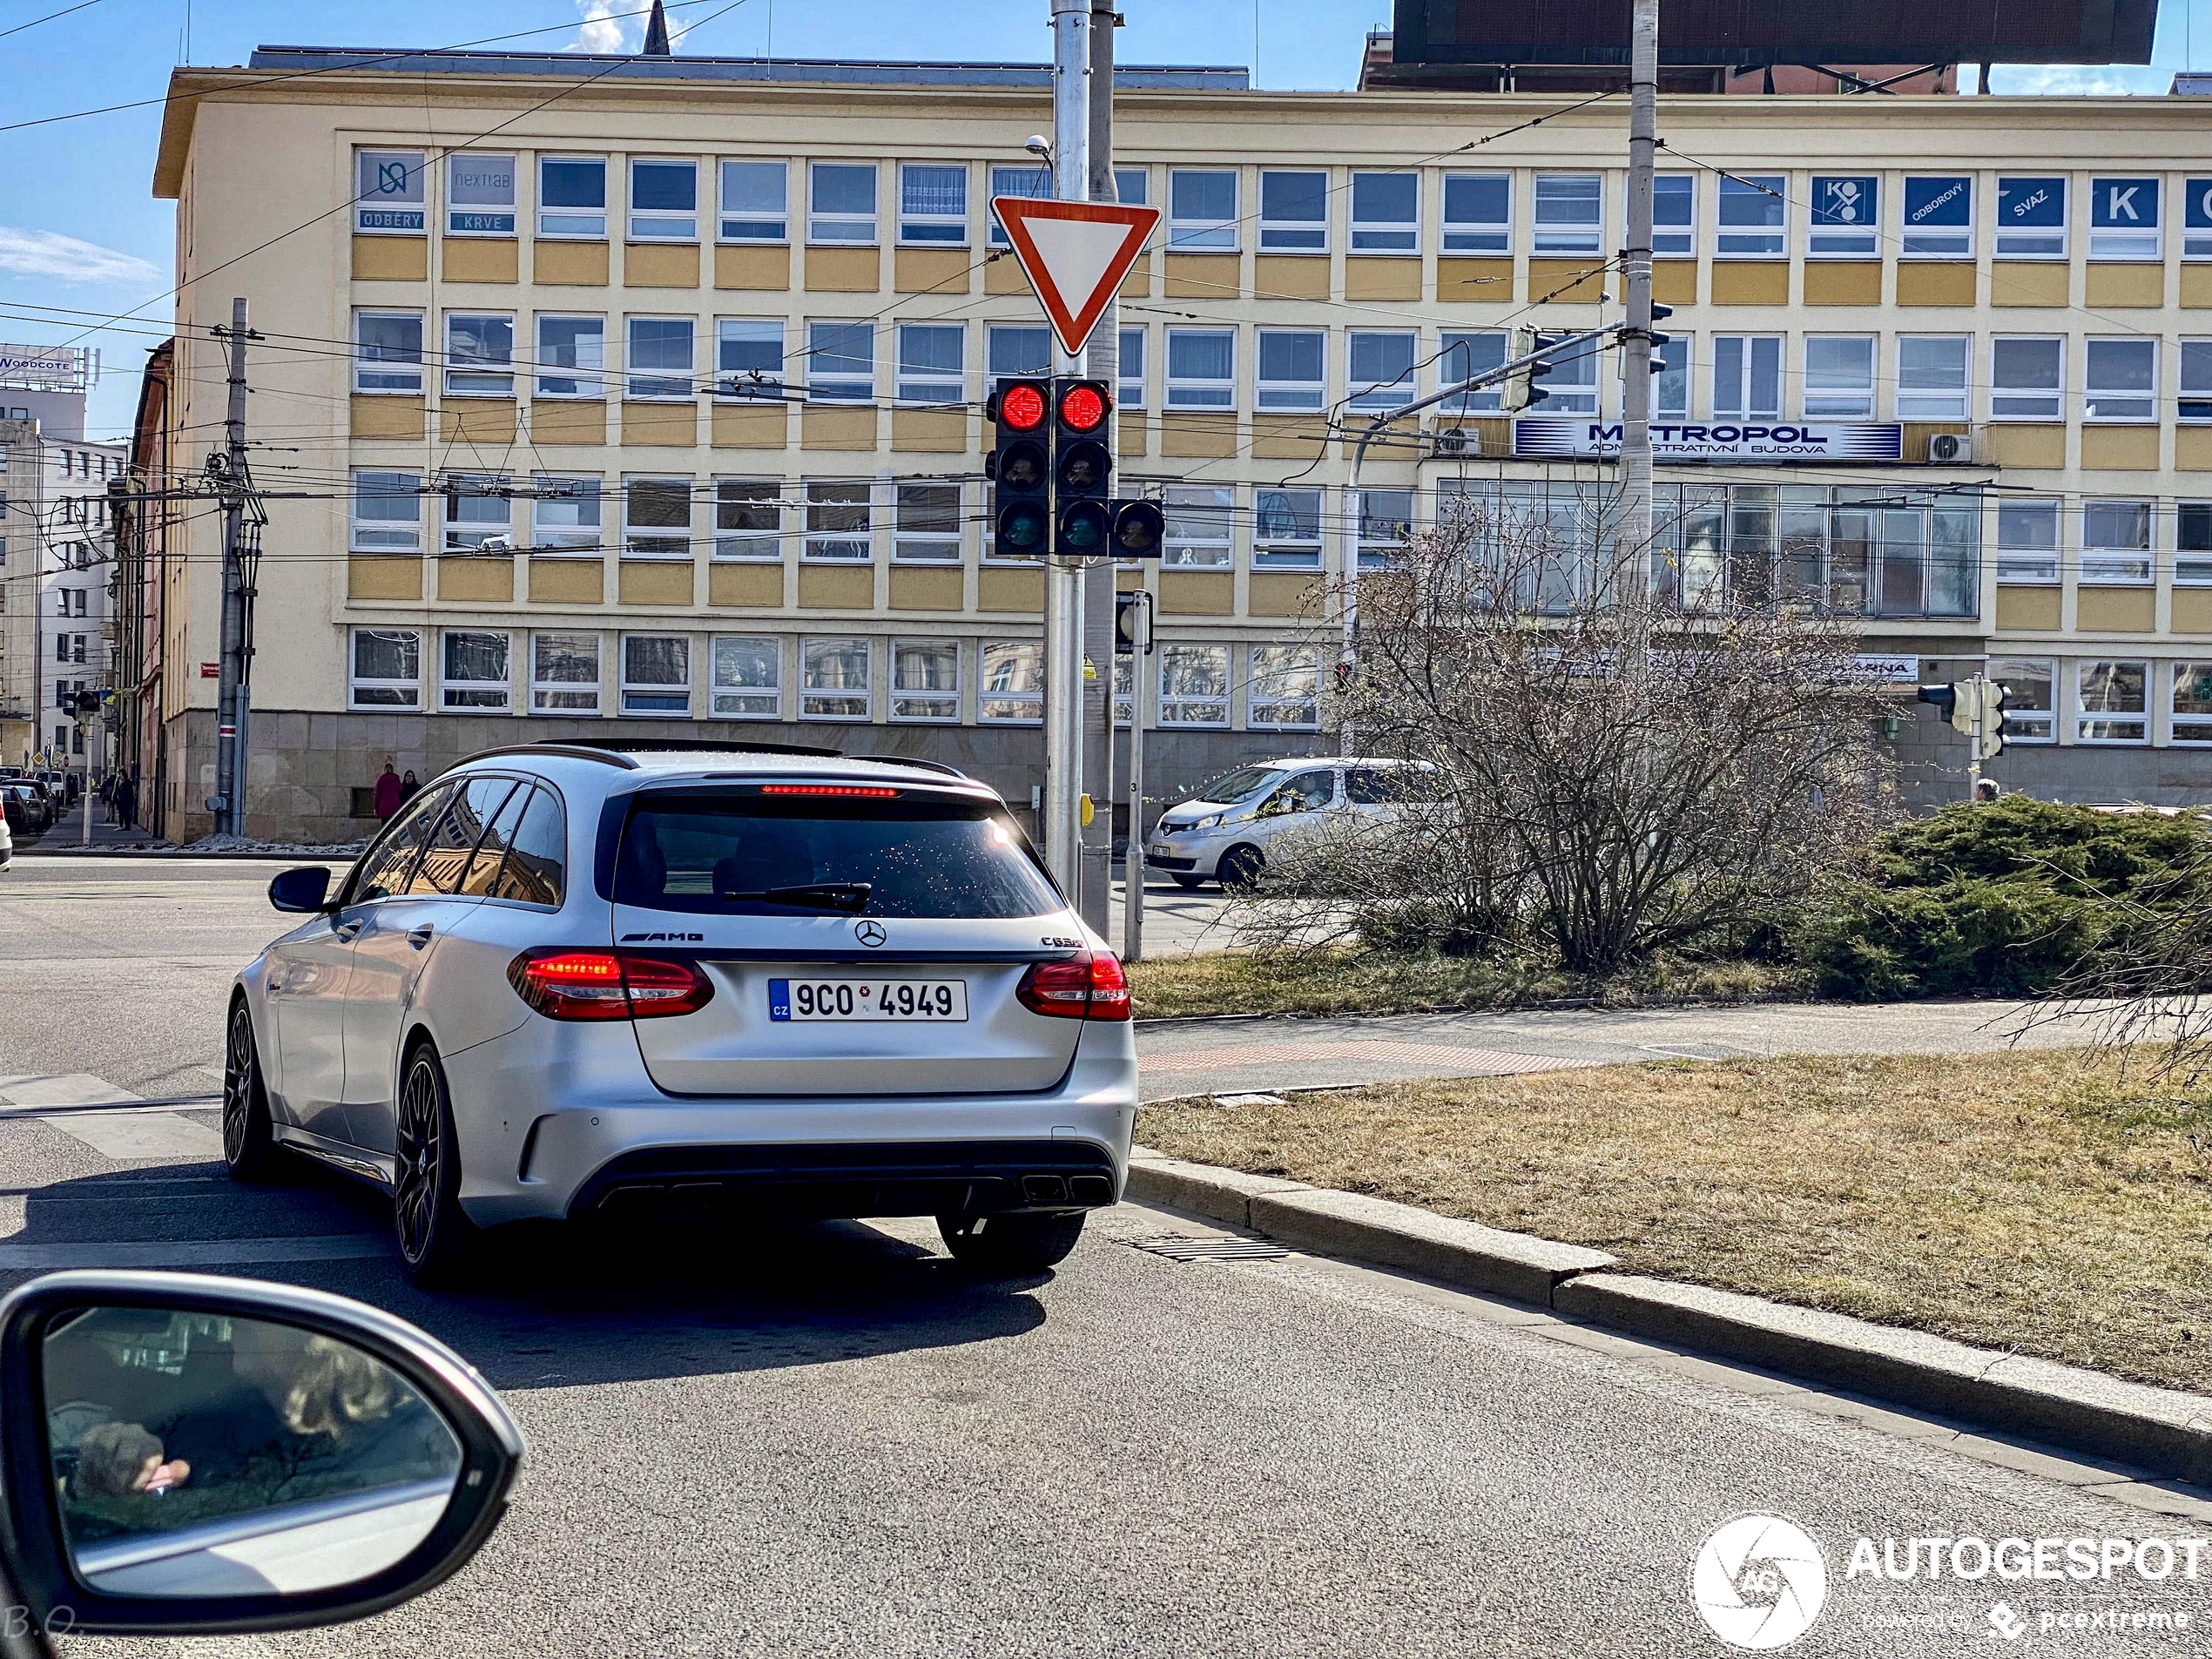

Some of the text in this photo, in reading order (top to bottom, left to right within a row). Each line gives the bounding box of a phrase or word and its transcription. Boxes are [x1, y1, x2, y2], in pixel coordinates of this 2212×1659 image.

[1912, 182, 1963, 221] ODBOROVÝ
[2013, 189, 2049, 217] SVAZ
[363, 212, 502, 229] ODBĚRY KRVE
[1588, 425, 1828, 443] MTROPOL
[1750, 445, 1827, 454] BUDOVA
[1130, 782, 1137, 792] 3
[646, 933, 704, 941] AMG
[879, 984, 953, 1016] 4949
[773, 1006, 788, 1015] CZ
